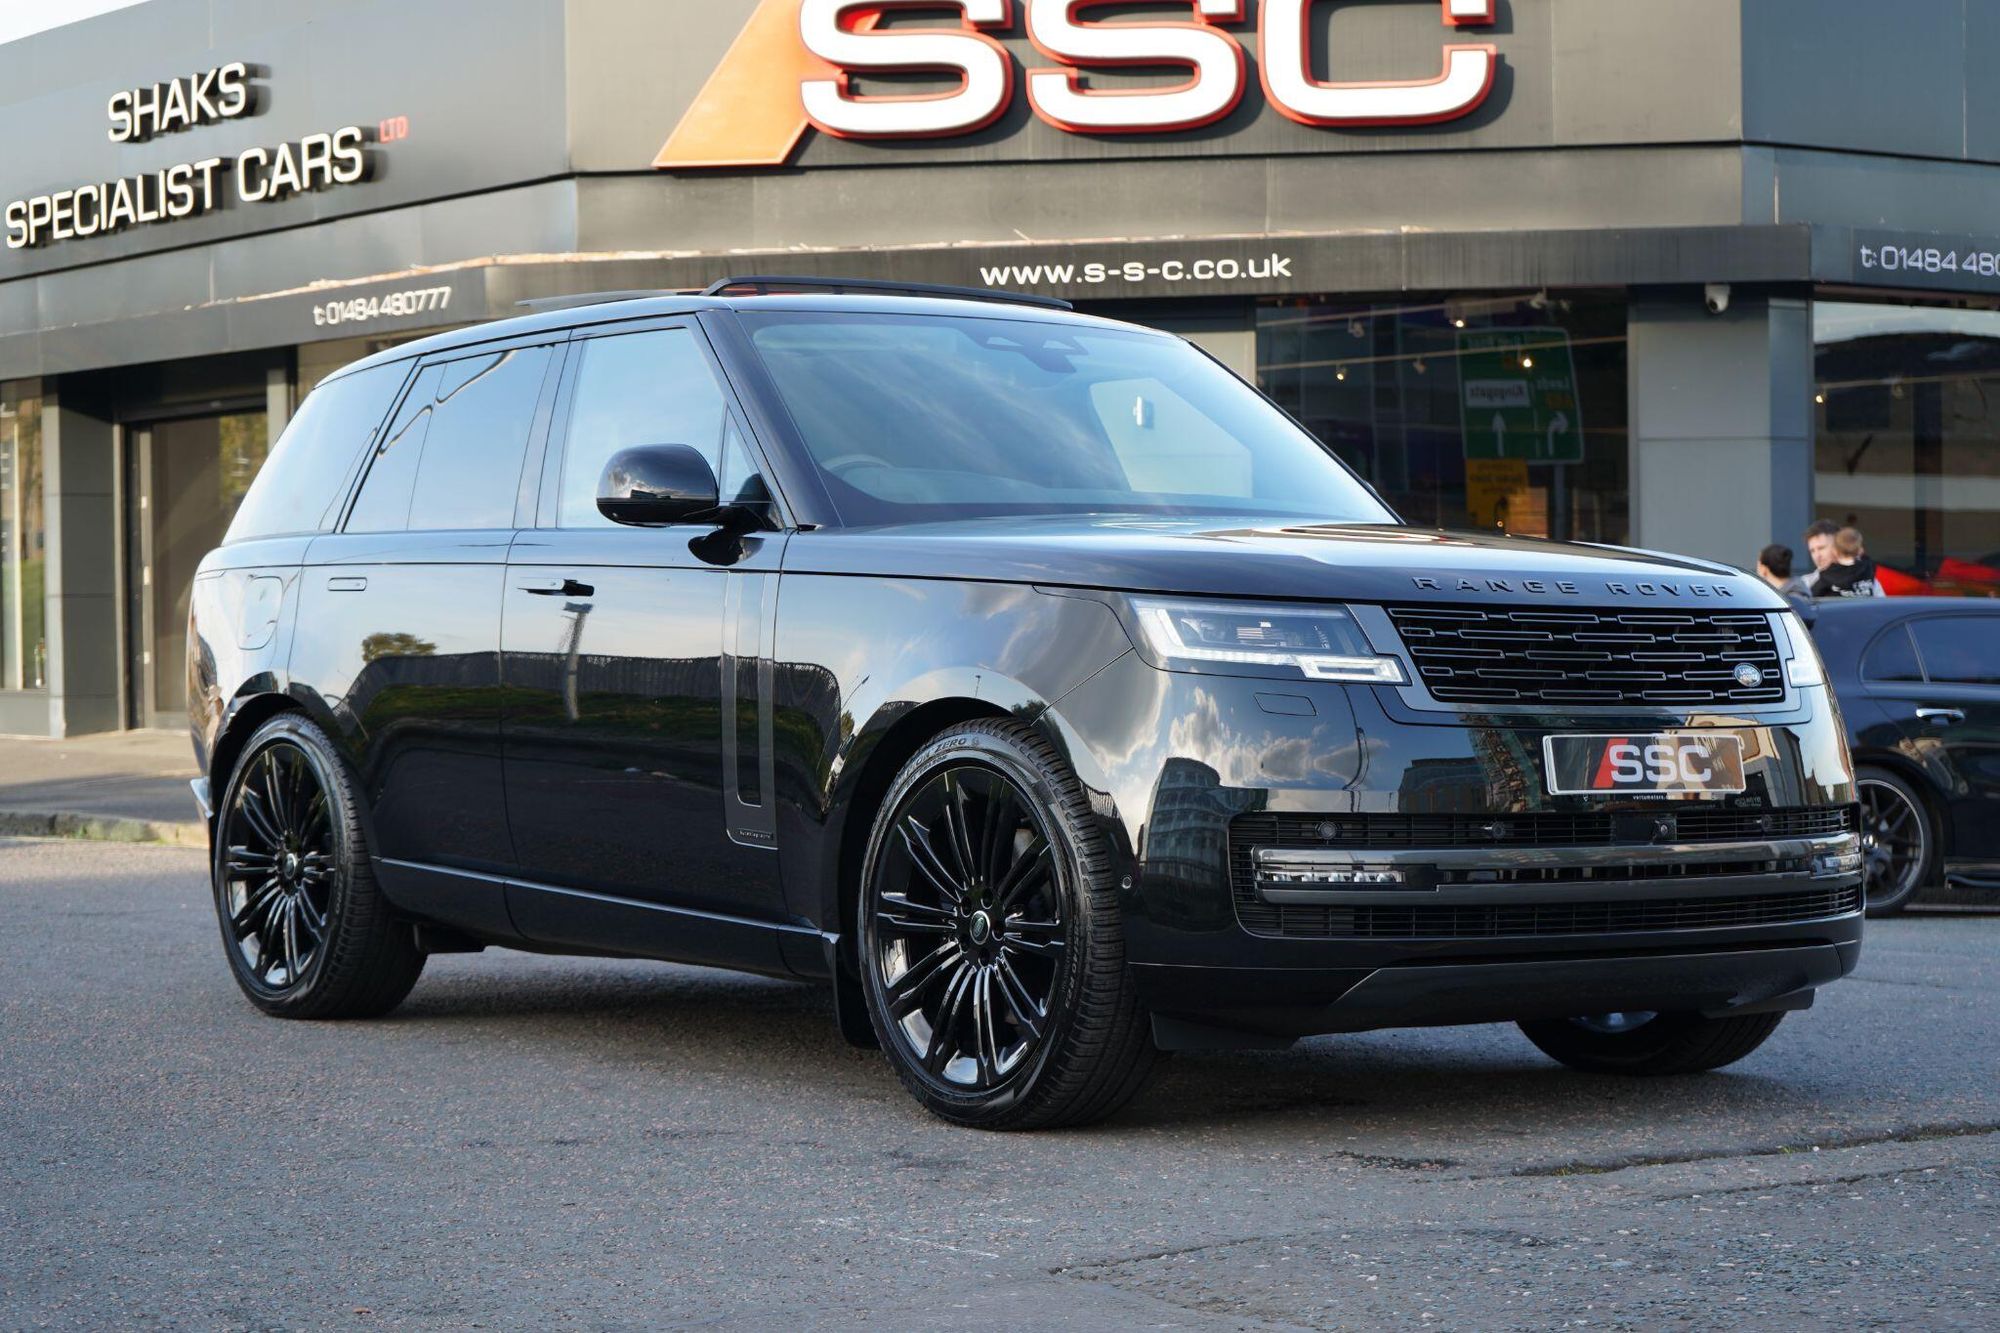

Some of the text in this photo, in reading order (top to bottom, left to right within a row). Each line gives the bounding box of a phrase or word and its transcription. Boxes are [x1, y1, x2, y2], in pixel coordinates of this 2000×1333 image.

[799, 0, 1497, 137] SSC
[107, 61, 248, 143] SHAKS
[379, 115, 409, 144] LTD
[5, 126, 364, 249] SPECIALIST CARS
[980, 252, 1292, 287] www.s-s-c.co.uk
[1412, 576, 1734, 598] RANGE ROVER
[1609, 744, 1712, 784] SSC
